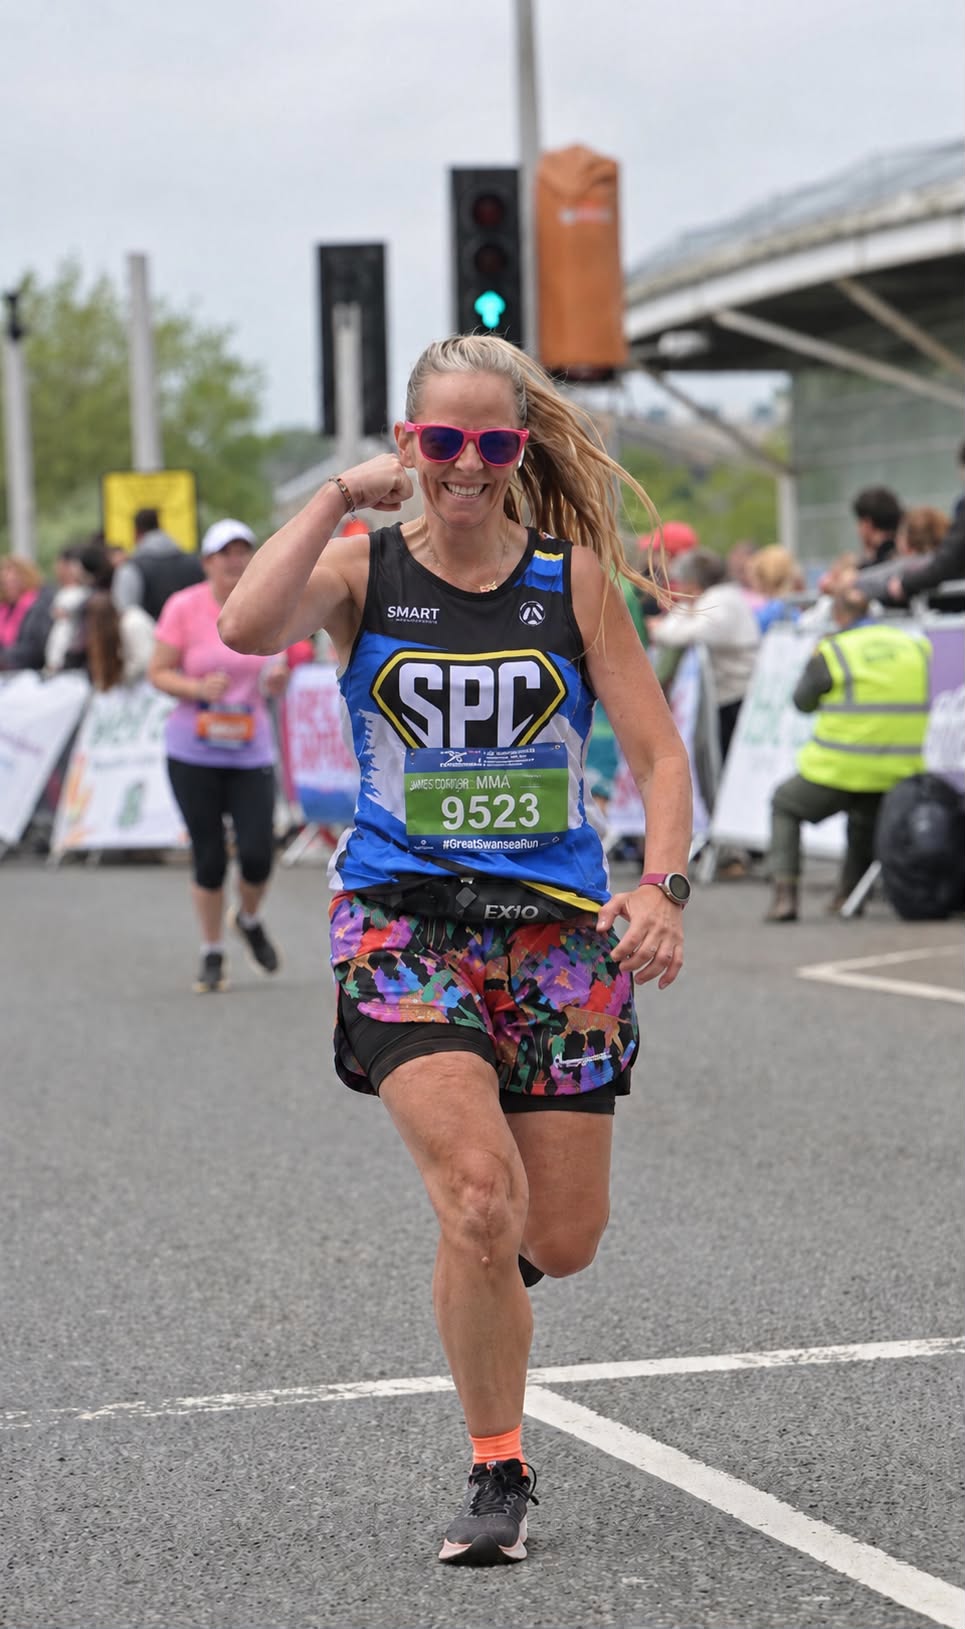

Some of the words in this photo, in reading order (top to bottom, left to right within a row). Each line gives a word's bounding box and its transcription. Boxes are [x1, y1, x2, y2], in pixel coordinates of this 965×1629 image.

[387, 606, 440, 620] SMART
[399, 661, 541, 748] SPC
[476, 775, 511, 789] MMA
[441, 793, 540, 830] 9523
[443, 838, 538, 850] #GreatSwanseaRun
